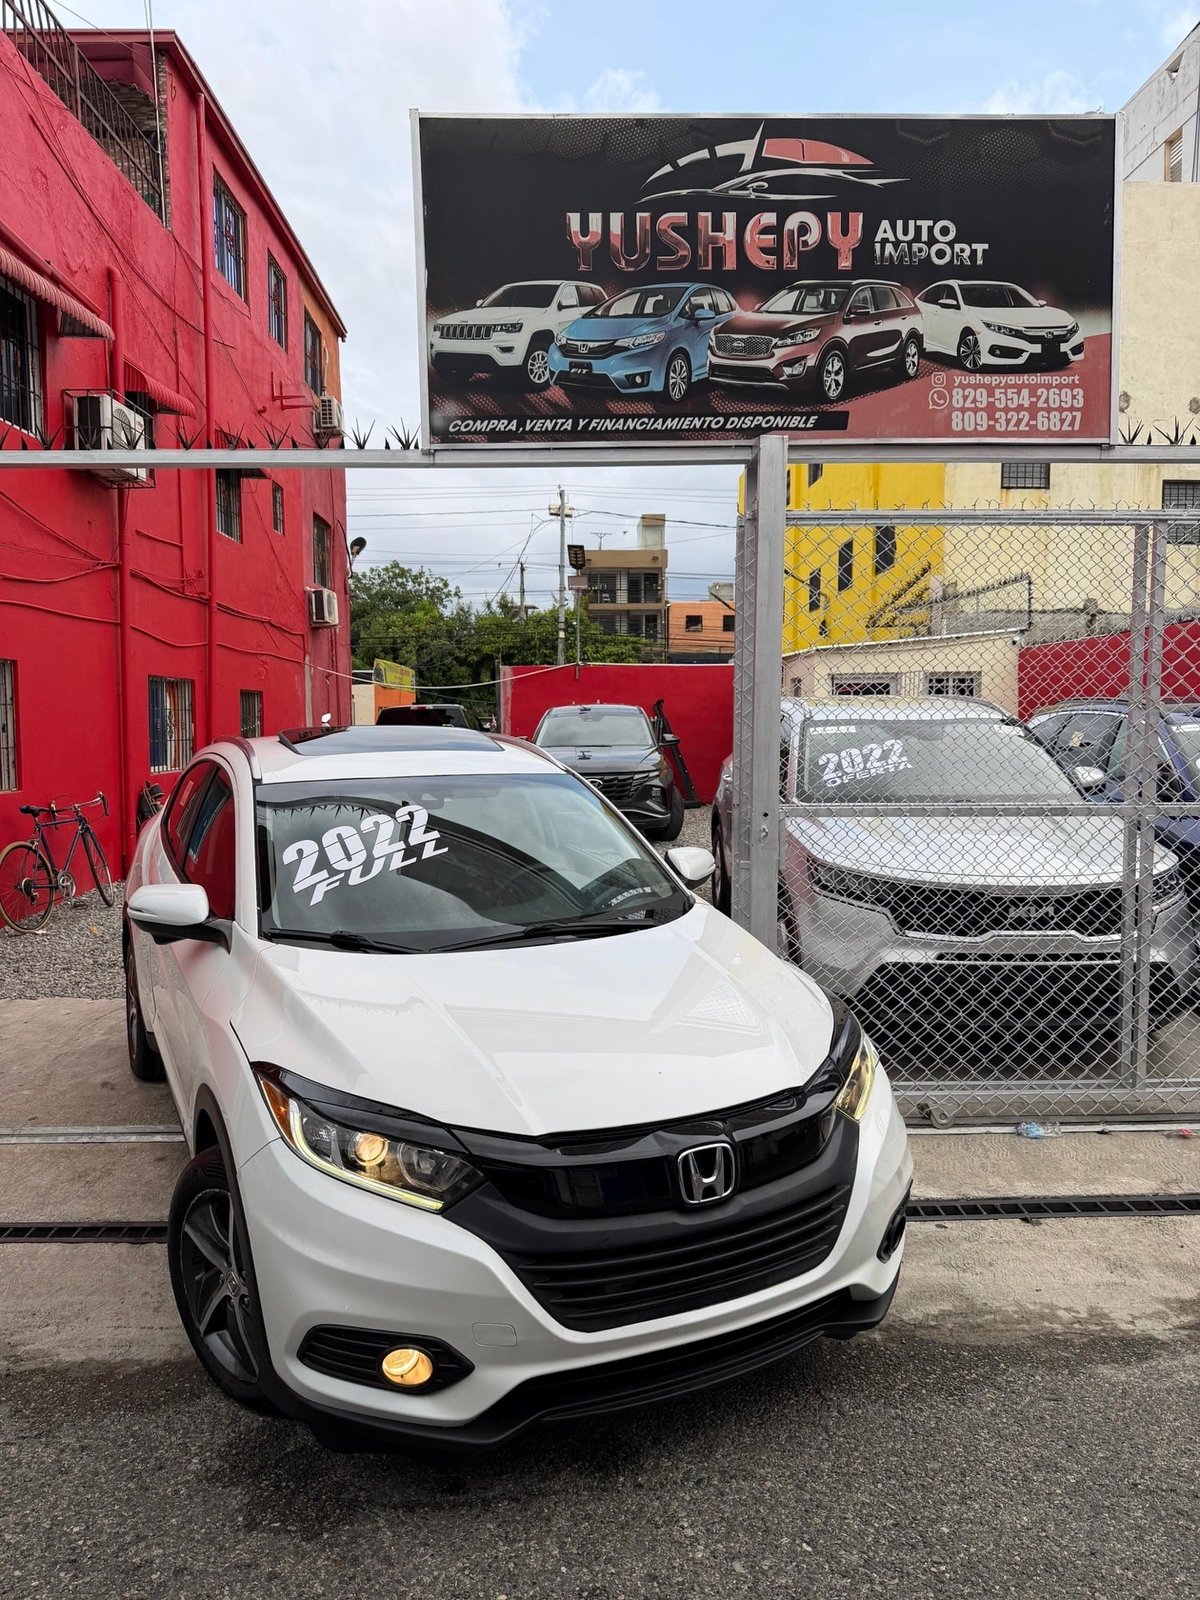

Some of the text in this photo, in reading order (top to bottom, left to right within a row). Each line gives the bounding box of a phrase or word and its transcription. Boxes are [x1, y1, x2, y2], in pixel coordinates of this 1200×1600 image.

[566, 211, 864, 271] YUSHEPY
[874, 219, 957, 243] AUTO
[873, 242, 989, 266] IMPORT
[953, 373, 1080, 386] yushepyautoimport
[951, 387, 1085, 409] 829-554-2693
[449, 419, 518, 432] COMPRA
[577, 418, 590, 431] Y
[590, 416, 726, 431] FINANCIAMIENTO
[725, 414, 819, 430] DISPONIBLE
[951, 410, 1082, 432] 809-322-6827
[818, 739, 909, 781] 2022
[282, 804, 441, 894] 2022
[309, 839, 449, 907] FULL
